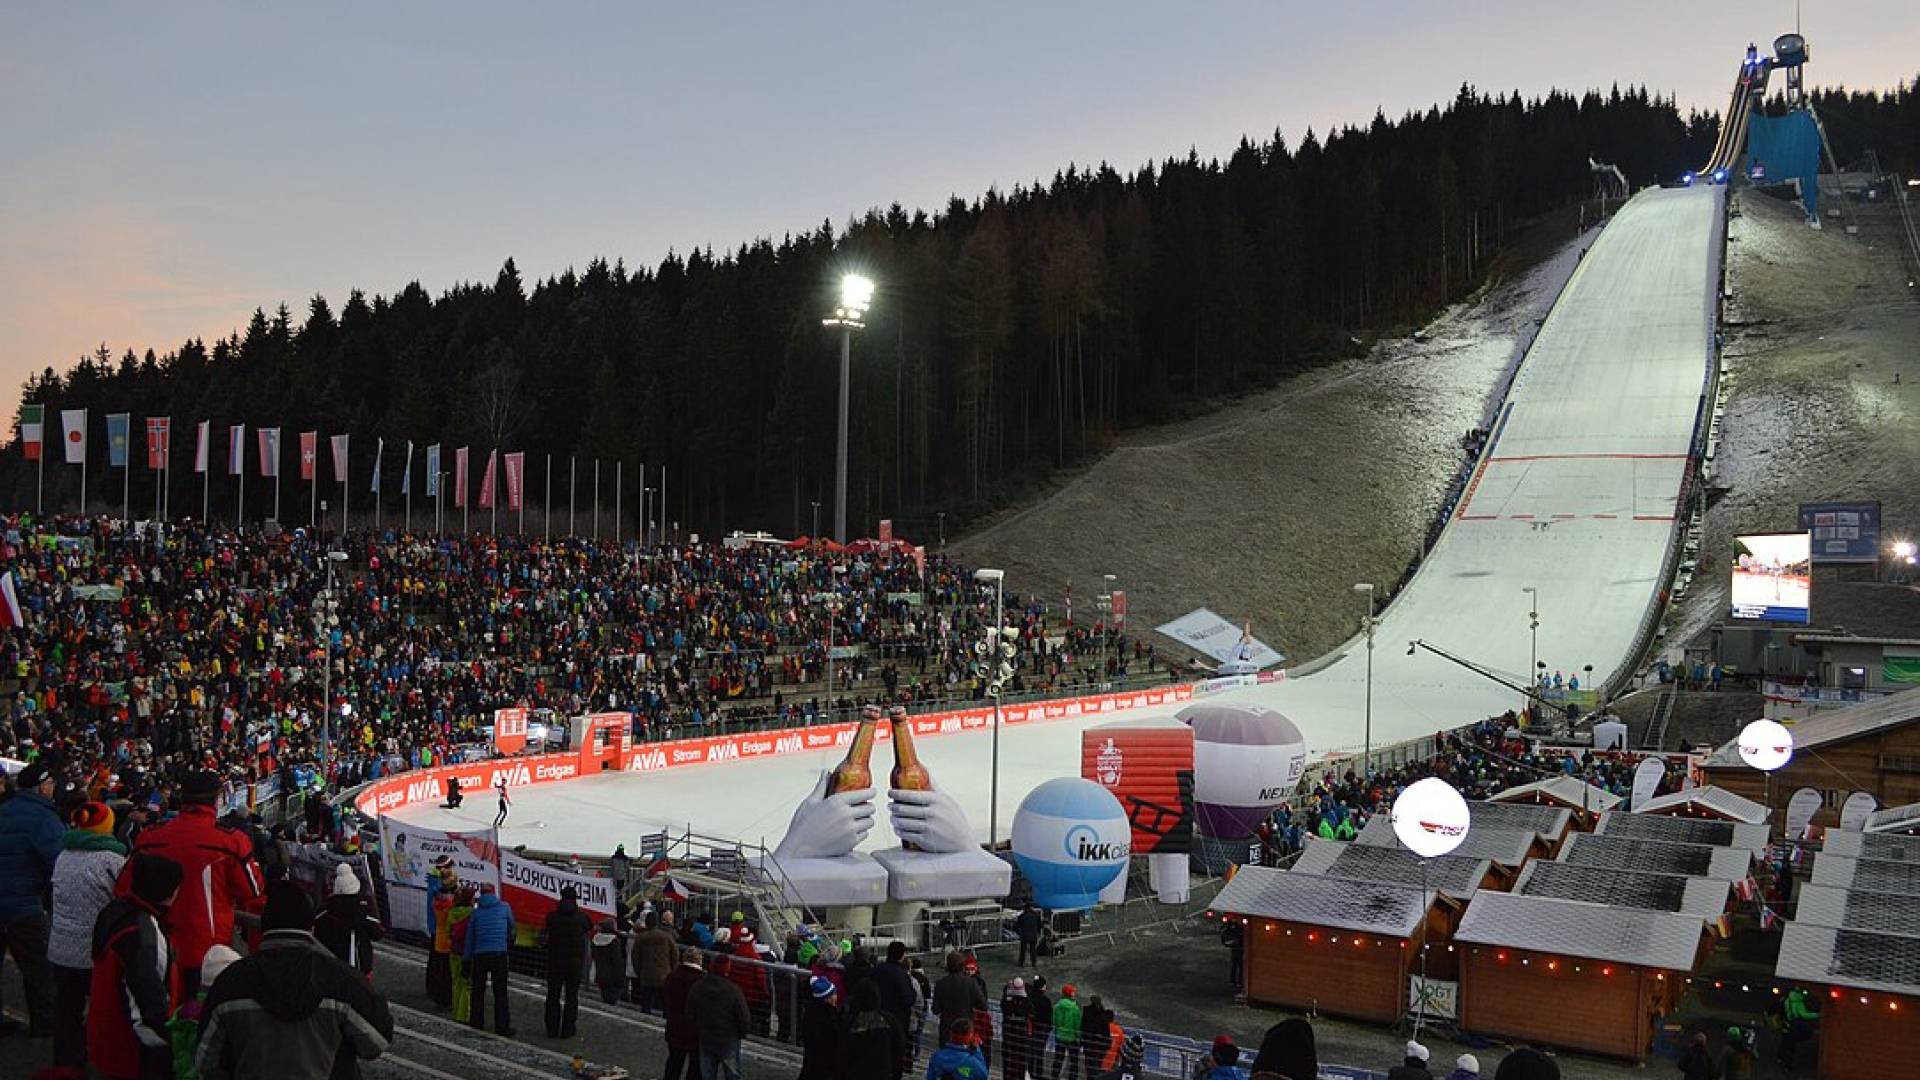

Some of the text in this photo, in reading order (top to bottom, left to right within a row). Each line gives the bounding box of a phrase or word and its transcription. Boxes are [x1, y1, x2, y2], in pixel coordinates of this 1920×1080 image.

[673, 750, 701, 762] Strom
[742, 740, 772, 754] Erdgas
[808, 733, 832, 746] Strom
[536, 763, 576, 779] Erdgas
